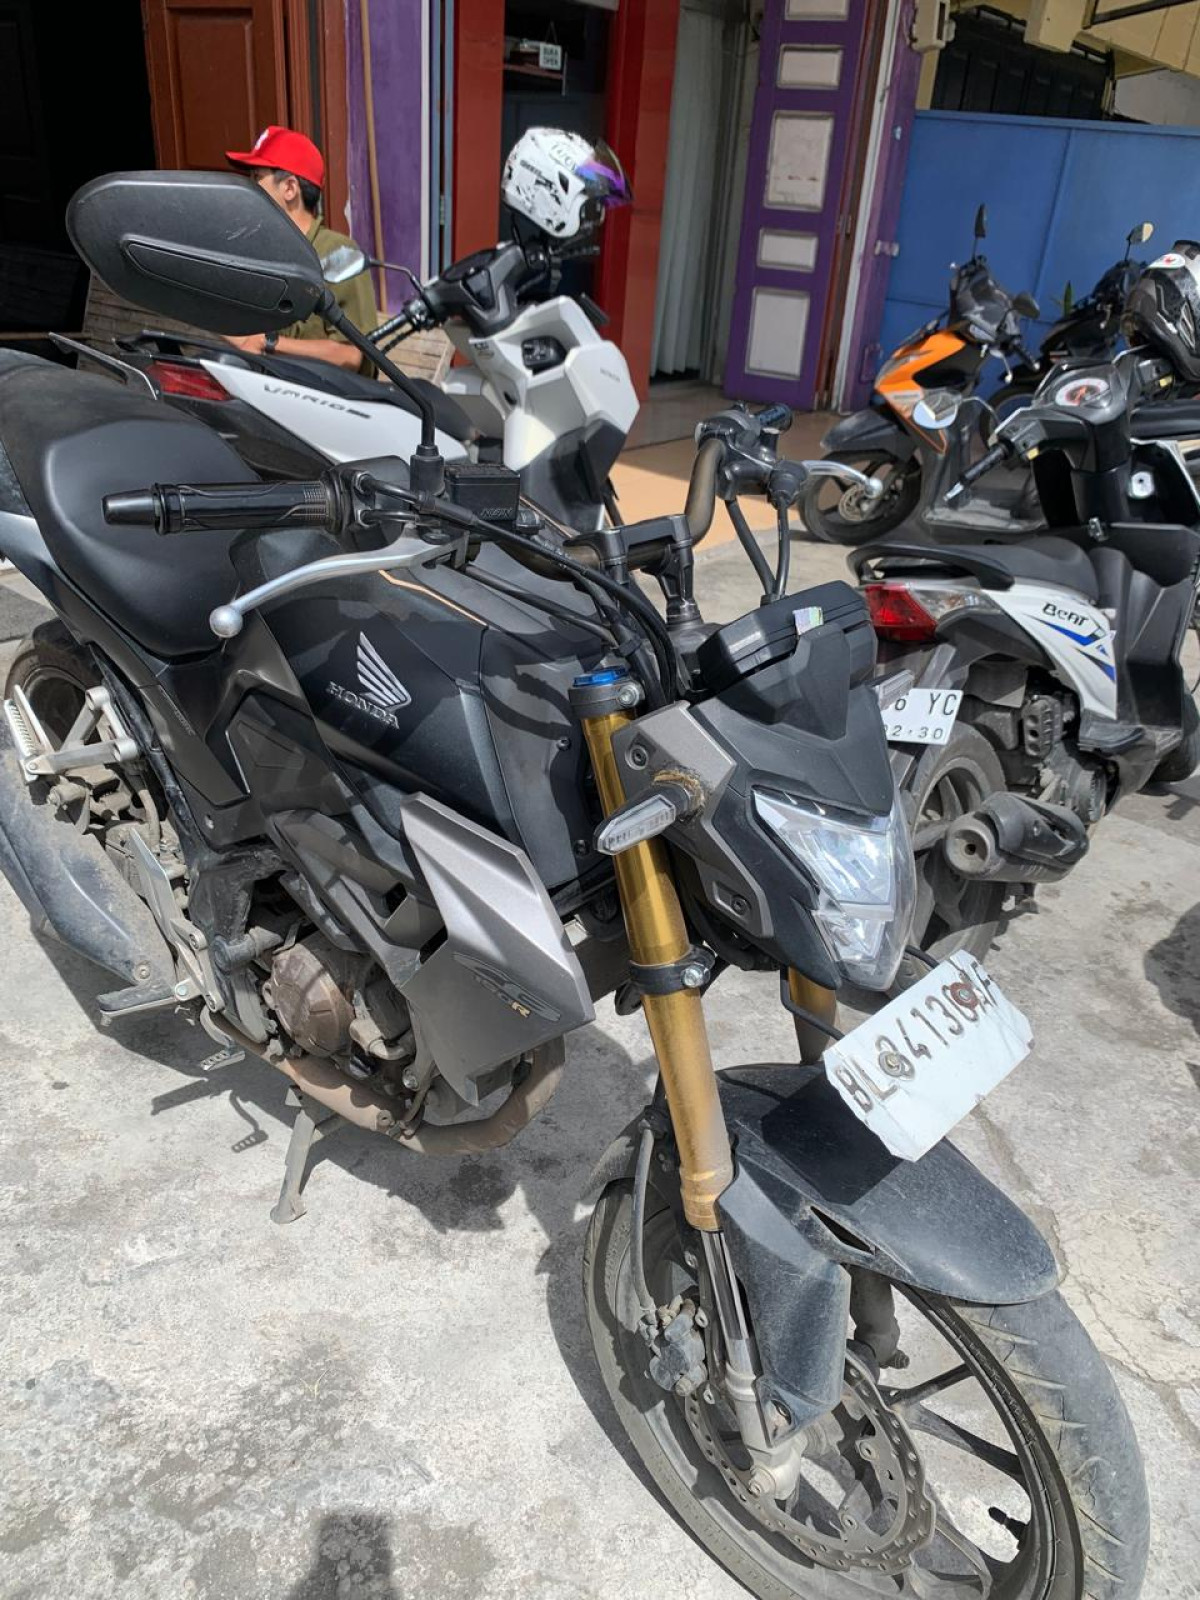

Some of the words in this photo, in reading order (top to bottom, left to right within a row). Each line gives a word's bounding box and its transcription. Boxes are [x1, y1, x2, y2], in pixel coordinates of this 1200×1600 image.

[326, 681, 400, 730] HONDA
[928, 692, 957, 716] YC
[835, 1057, 898, 1113] BL
